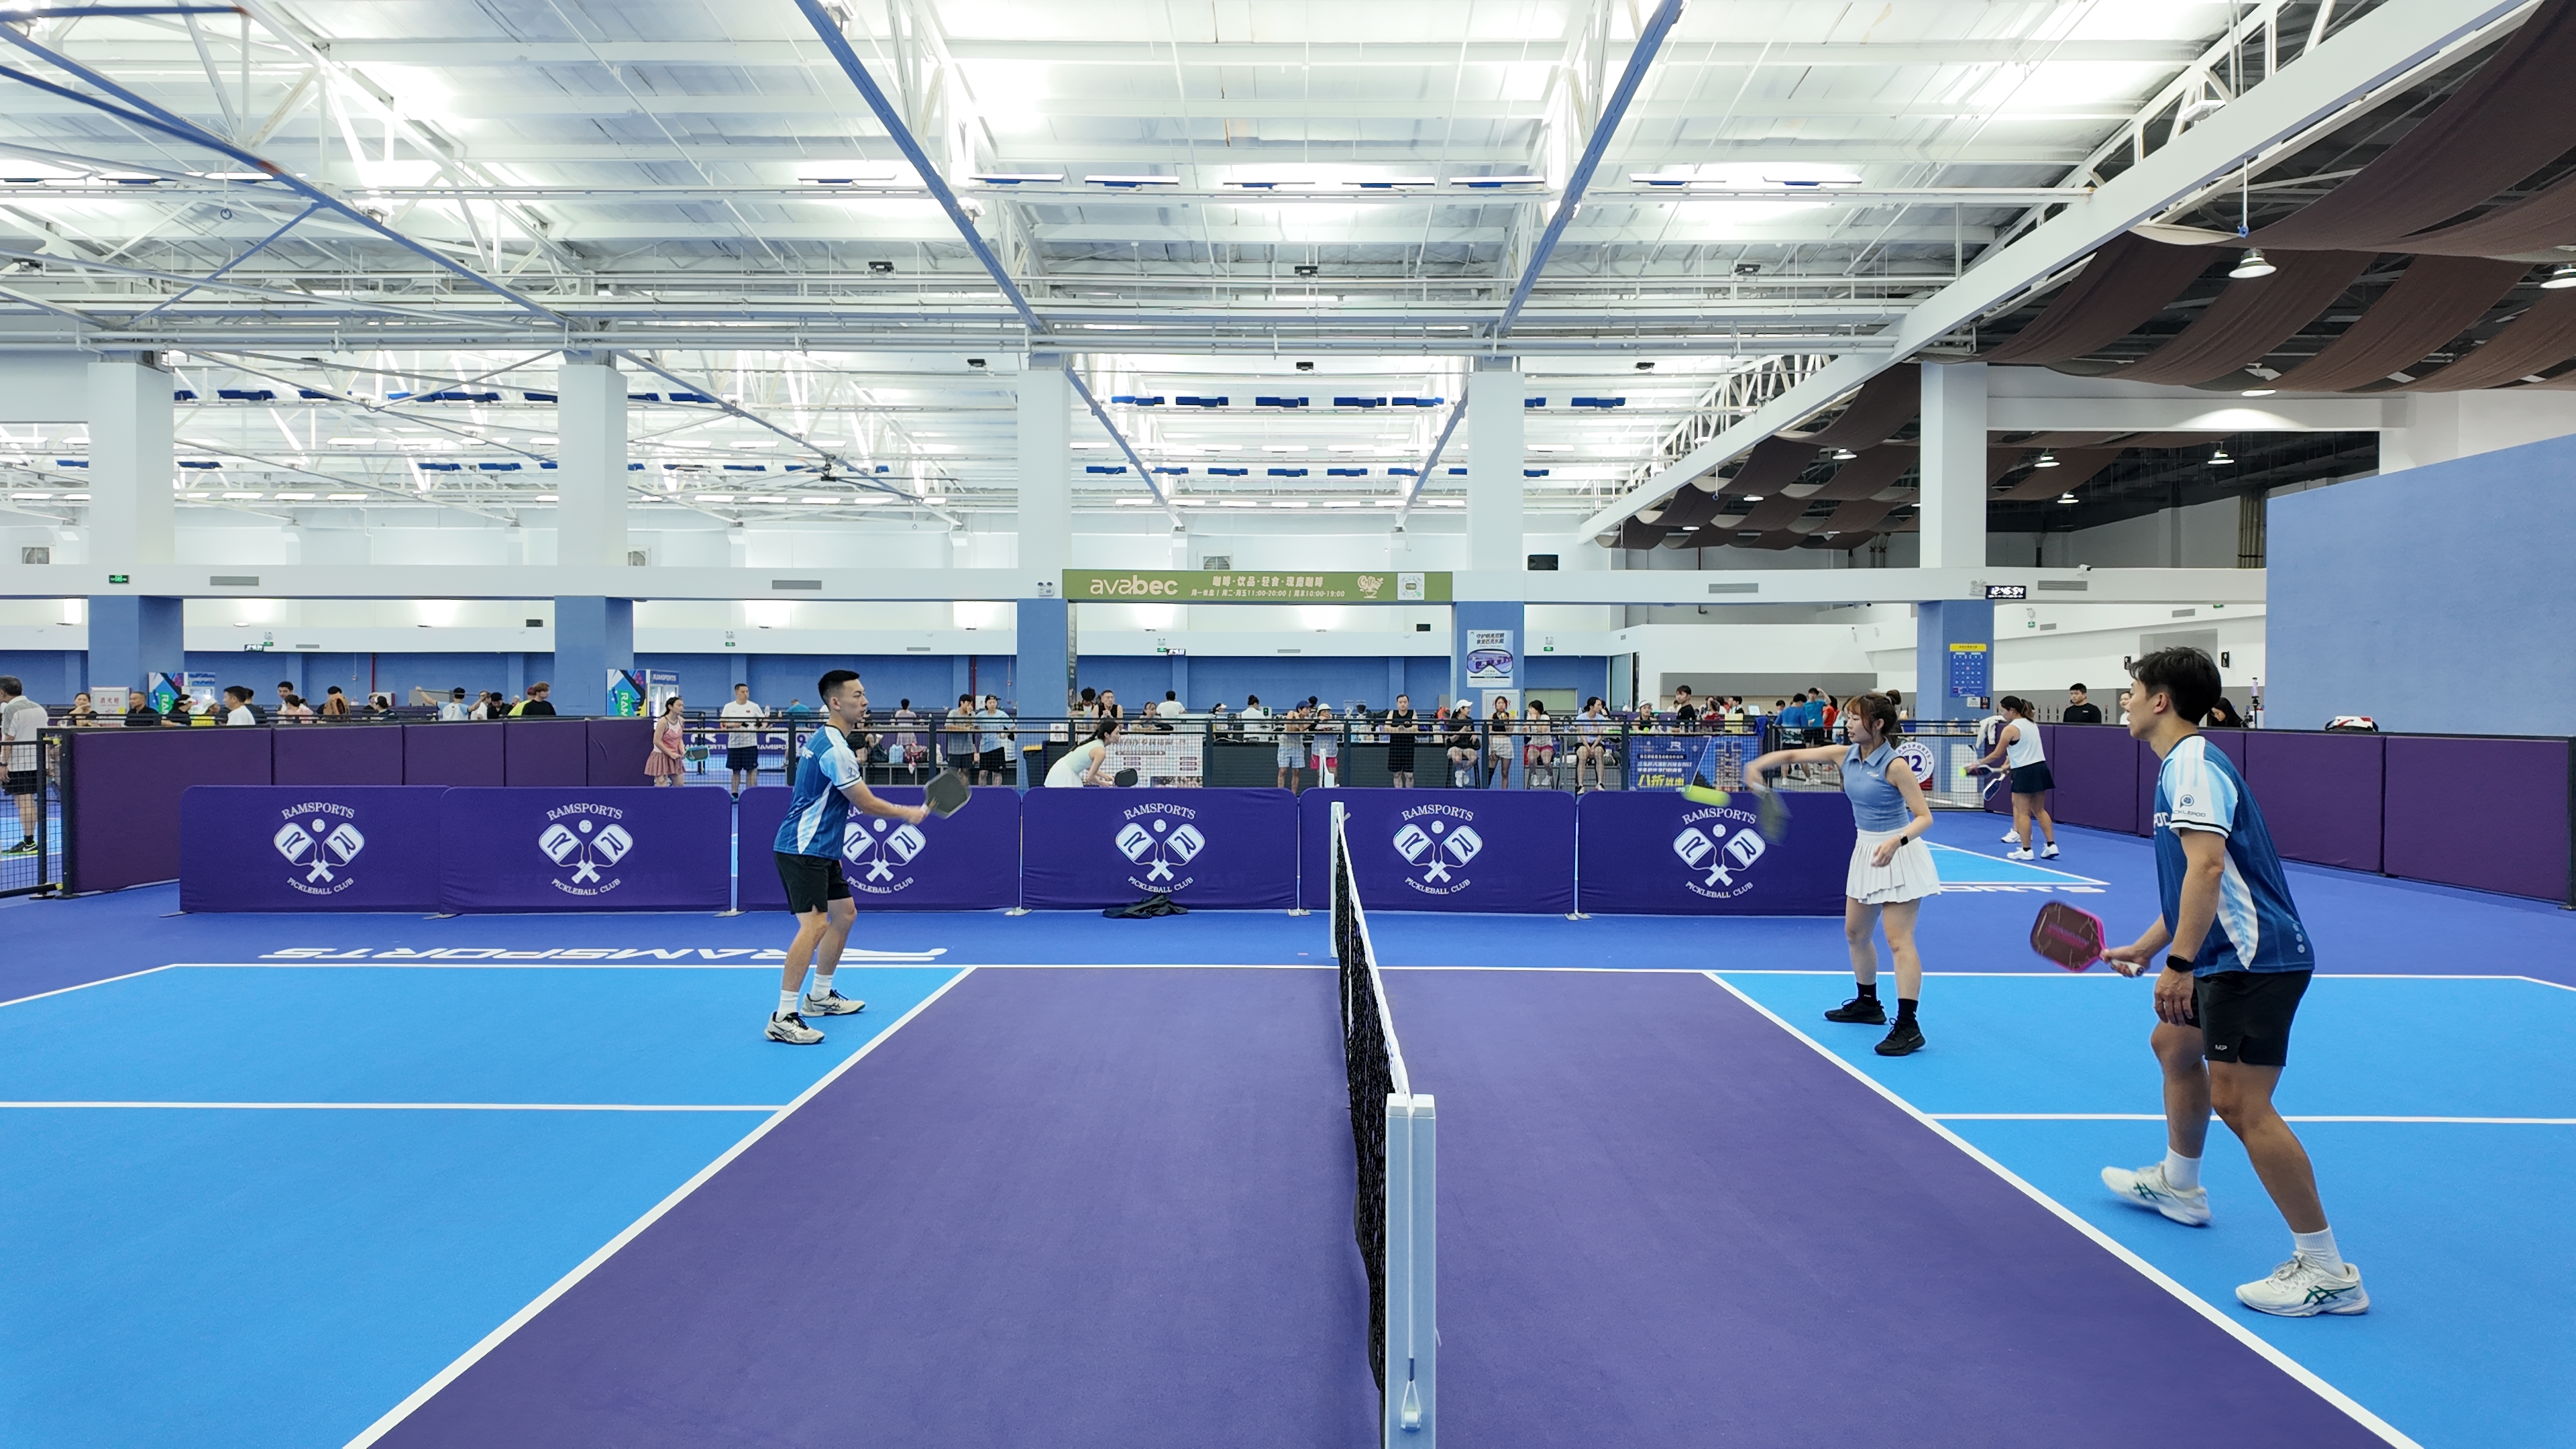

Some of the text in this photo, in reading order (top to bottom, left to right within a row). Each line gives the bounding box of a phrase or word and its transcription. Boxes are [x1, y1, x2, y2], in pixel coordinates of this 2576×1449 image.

[1090, 575, 1178, 595] avabec
[282, 802, 354, 820] RAMSPORTS
[547, 803, 623, 820] RAMSPORTS
[1124, 803, 1195, 820] RAMSPORTS
[1401, 804, 1474, 820] RAMSPORTS
[1682, 808, 1757, 825] RAMSPORTS
[287, 877, 354, 894] PICKLEBALL CLUB
[551, 878, 621, 895] PICKLEBALL CLUB
[847, 876, 914, 894] PICKLEBALL CLUB
[1128, 876, 1193, 893] PICKLEBALL CLUB
[1405, 877, 1470, 894] PICKLEBALL CLUB
[1686, 881, 1754, 898] PICKLEBALL CLUB
